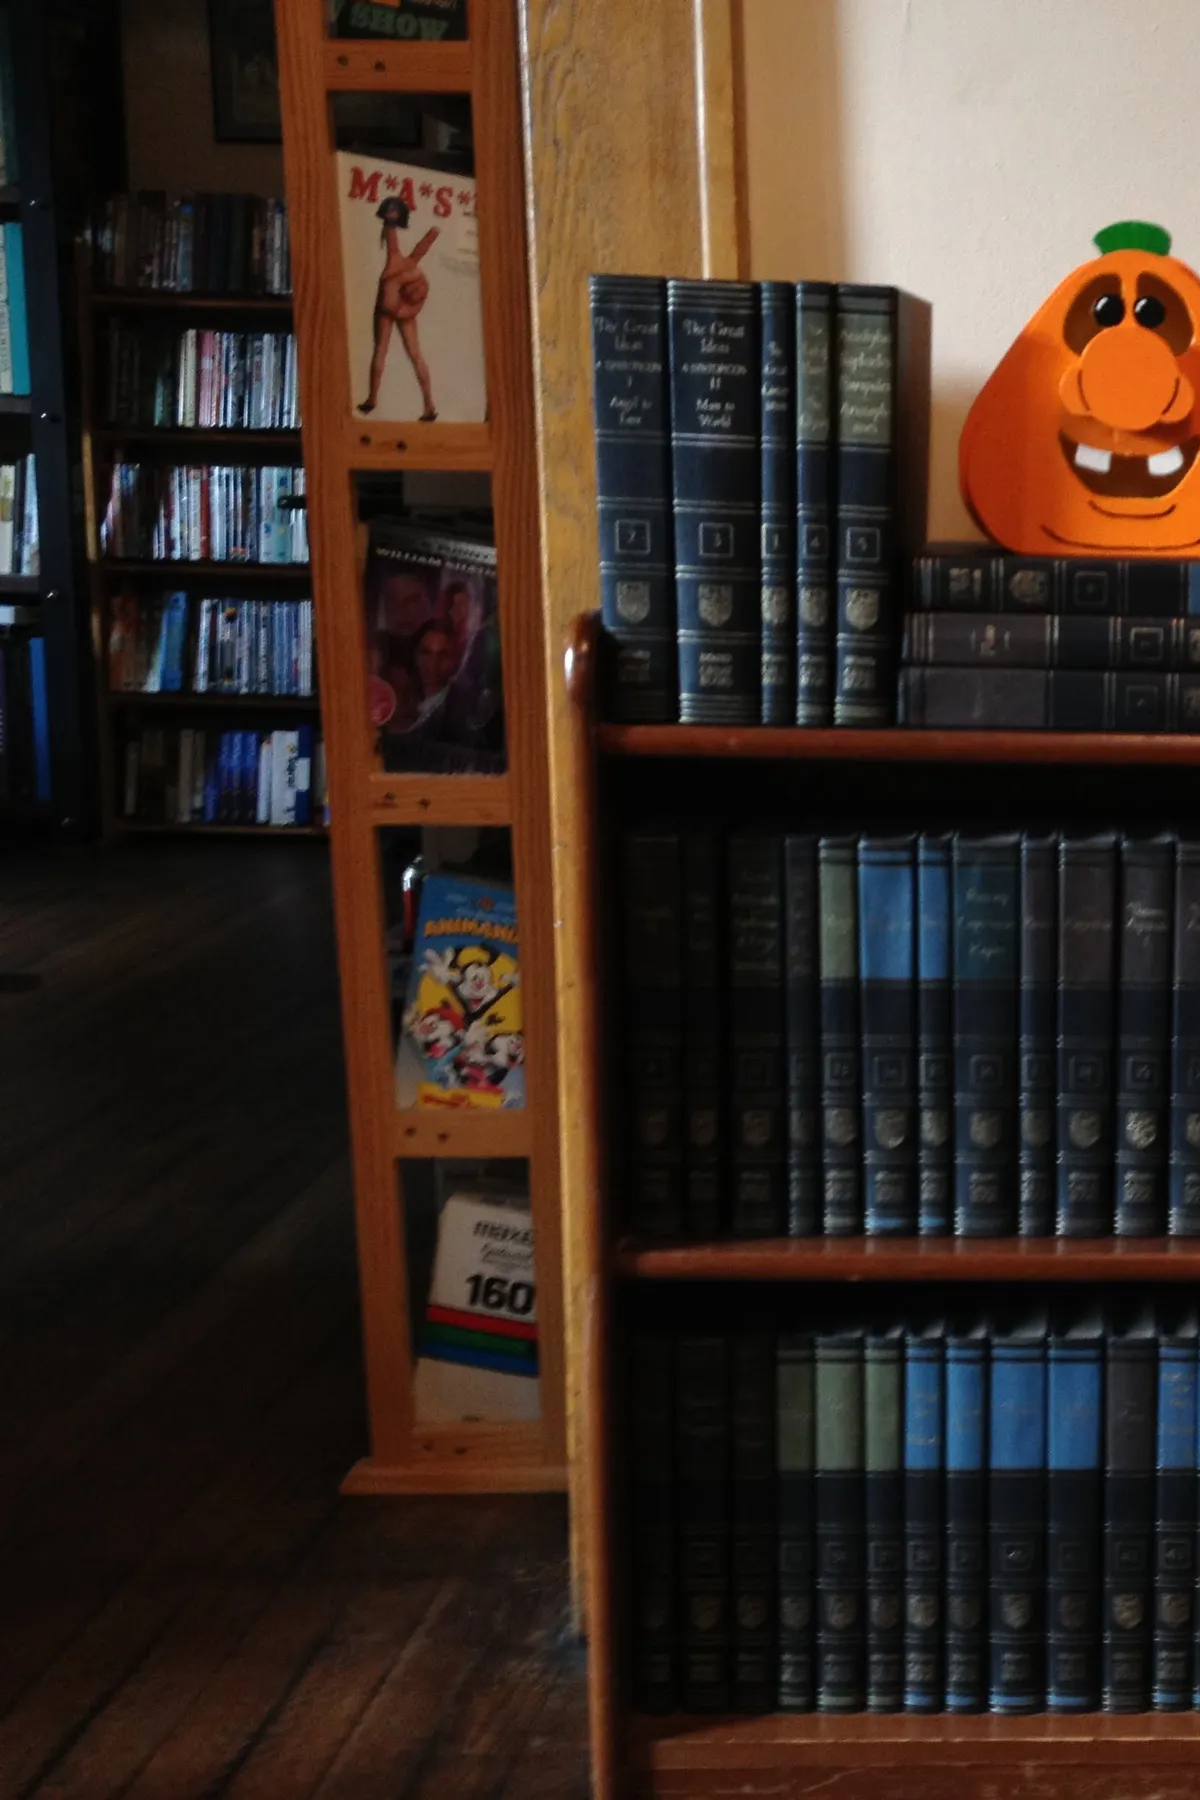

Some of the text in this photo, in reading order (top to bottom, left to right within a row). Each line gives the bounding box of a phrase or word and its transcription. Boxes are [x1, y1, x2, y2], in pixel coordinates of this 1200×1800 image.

[348, 3, 449, 40] SHOW
[683, 318, 746, 338] The Great
[375, 547, 442, 568] WILLIAM
[465, 1274, 535, 1315] 160
